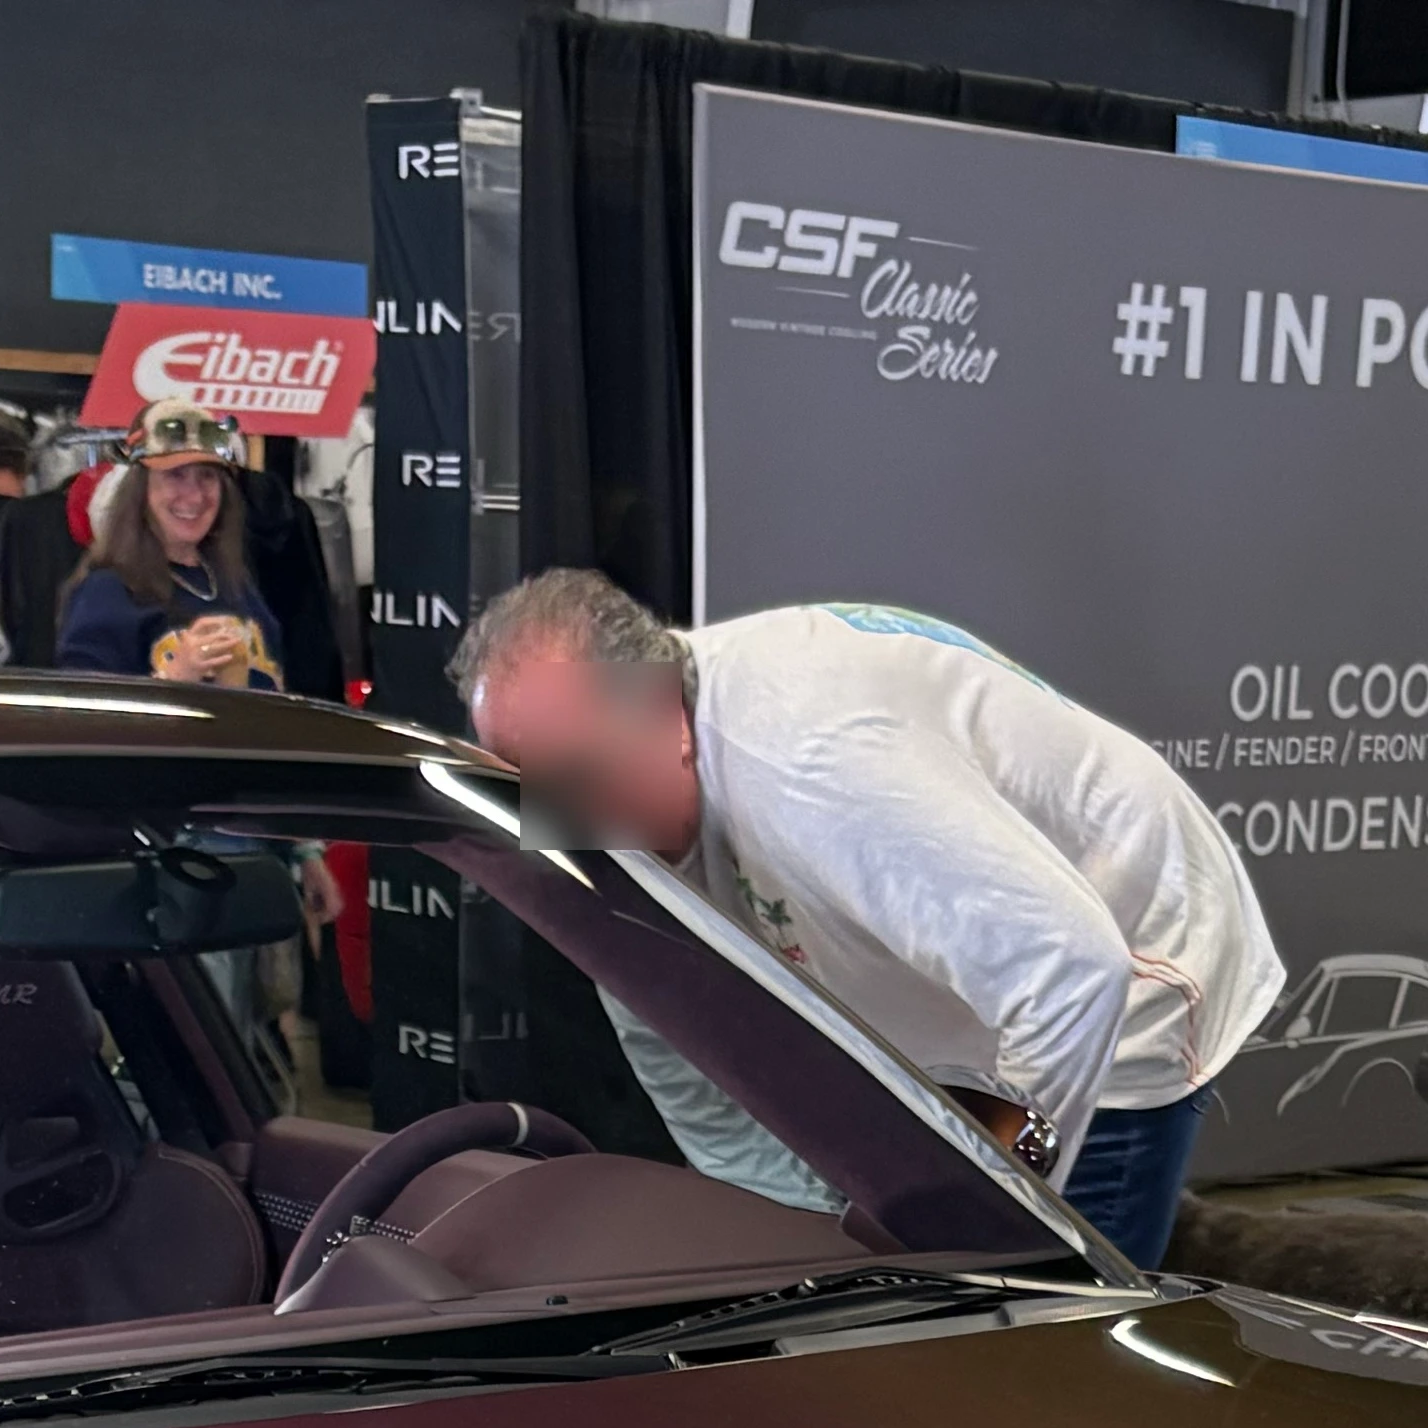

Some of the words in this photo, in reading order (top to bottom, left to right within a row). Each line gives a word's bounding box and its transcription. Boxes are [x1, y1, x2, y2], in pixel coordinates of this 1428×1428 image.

[719, 200, 901, 279] CSF
[143, 263, 228, 296] EIBACH
[232, 272, 284, 300] INC.
[860, 258, 979, 326] Classic
[876, 324, 999, 385] Series
[1112, 281, 1207, 381] #1
[1241, 289, 1329, 386] IN
[132, 331, 341, 415] Eibach
[1229, 664, 1314, 722] OIL
[1233, 735, 1338, 768] FENDER
